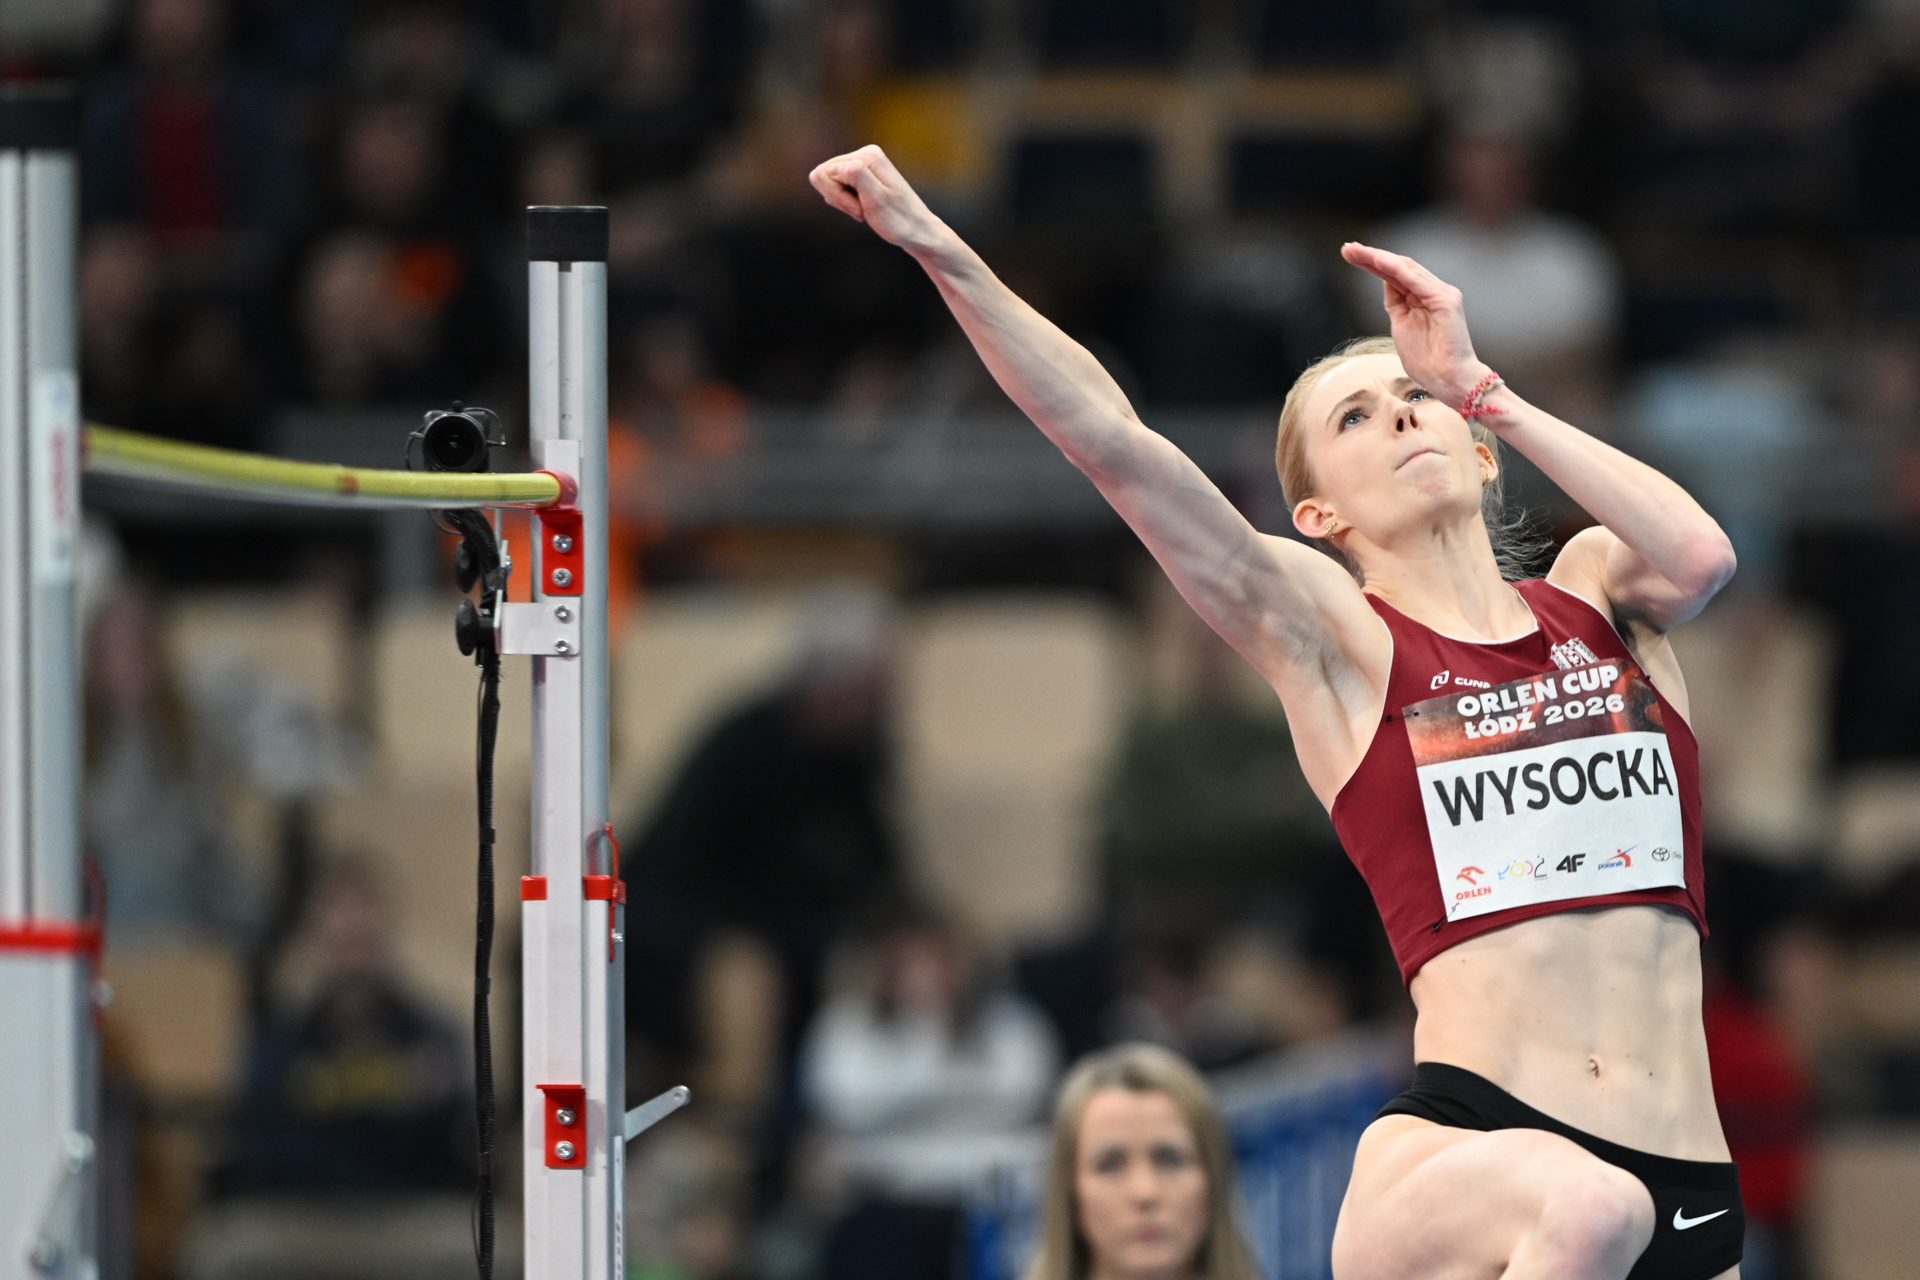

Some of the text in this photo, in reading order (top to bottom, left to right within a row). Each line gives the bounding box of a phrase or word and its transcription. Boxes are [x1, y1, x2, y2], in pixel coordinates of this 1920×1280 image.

[1456, 664, 1619, 717] ORLEN CUP
[1464, 693, 1625, 739] ŁÓDŹ 2026
[1432, 747, 1674, 827] WYSOCKA
[1556, 853, 1586, 873] 4F
[1455, 886, 1492, 900] ORLEN
